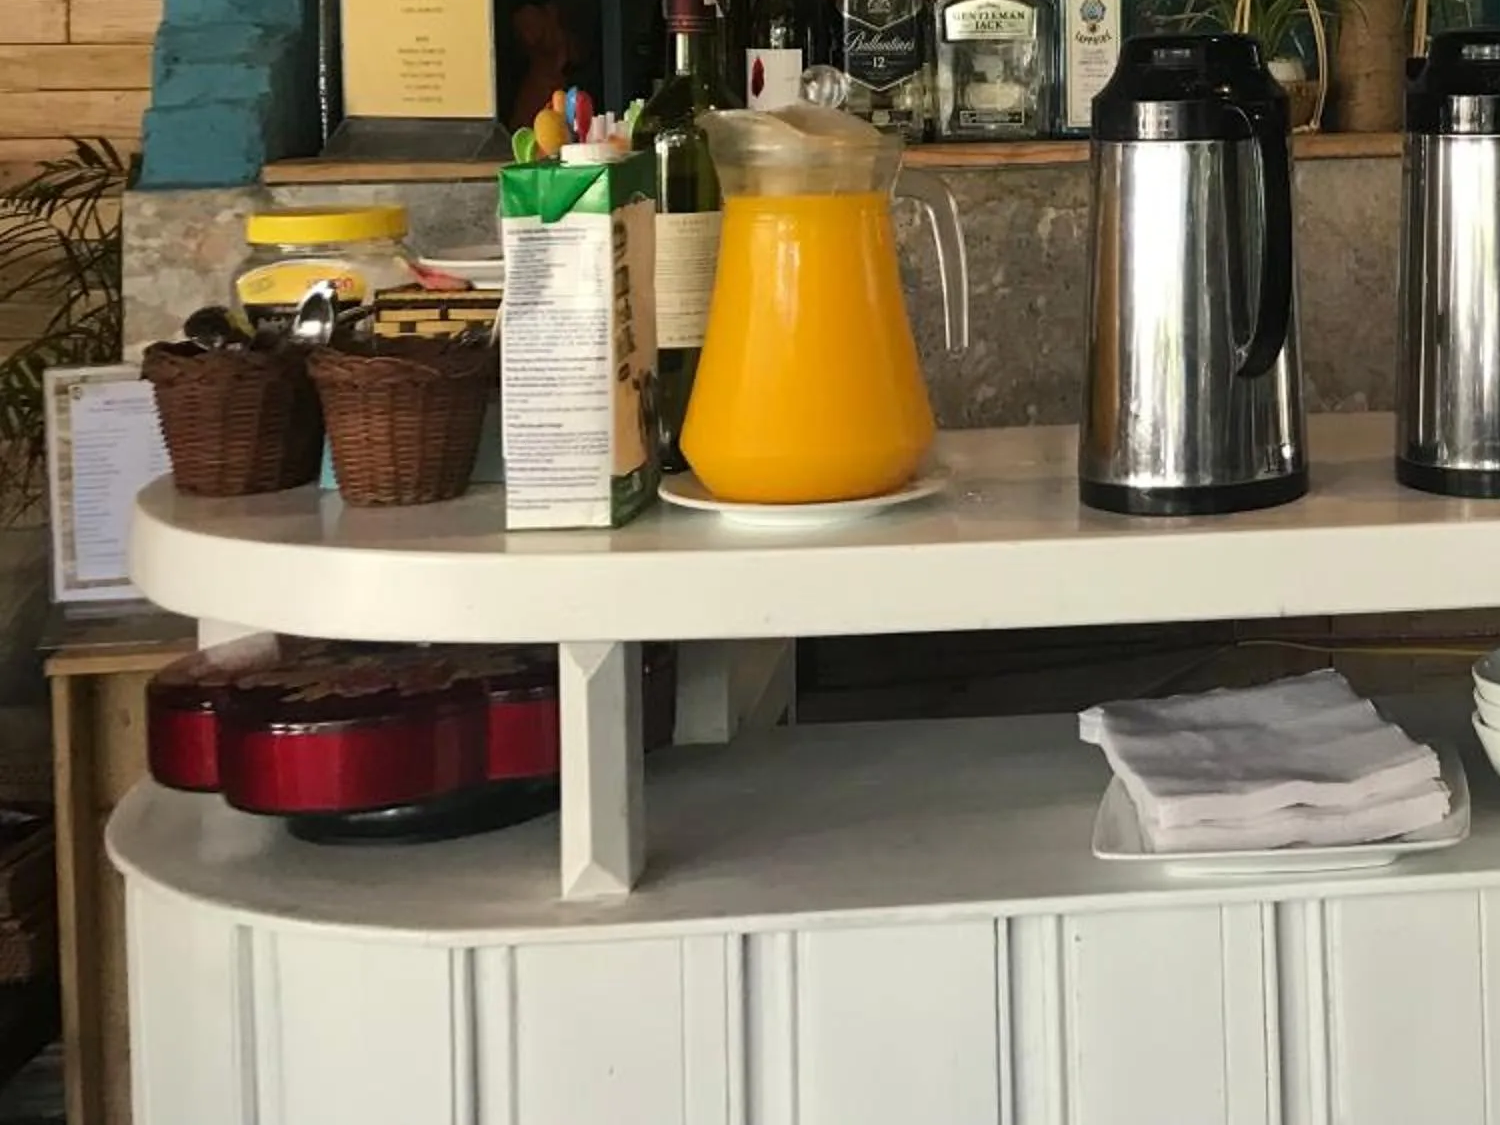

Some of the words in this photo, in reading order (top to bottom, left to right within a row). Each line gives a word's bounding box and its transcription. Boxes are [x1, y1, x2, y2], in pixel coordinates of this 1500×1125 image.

[952, 10, 1025, 21] GENTLEMAN
[974, 20, 1003, 31] JACK
[873, 56, 887, 68] 12
